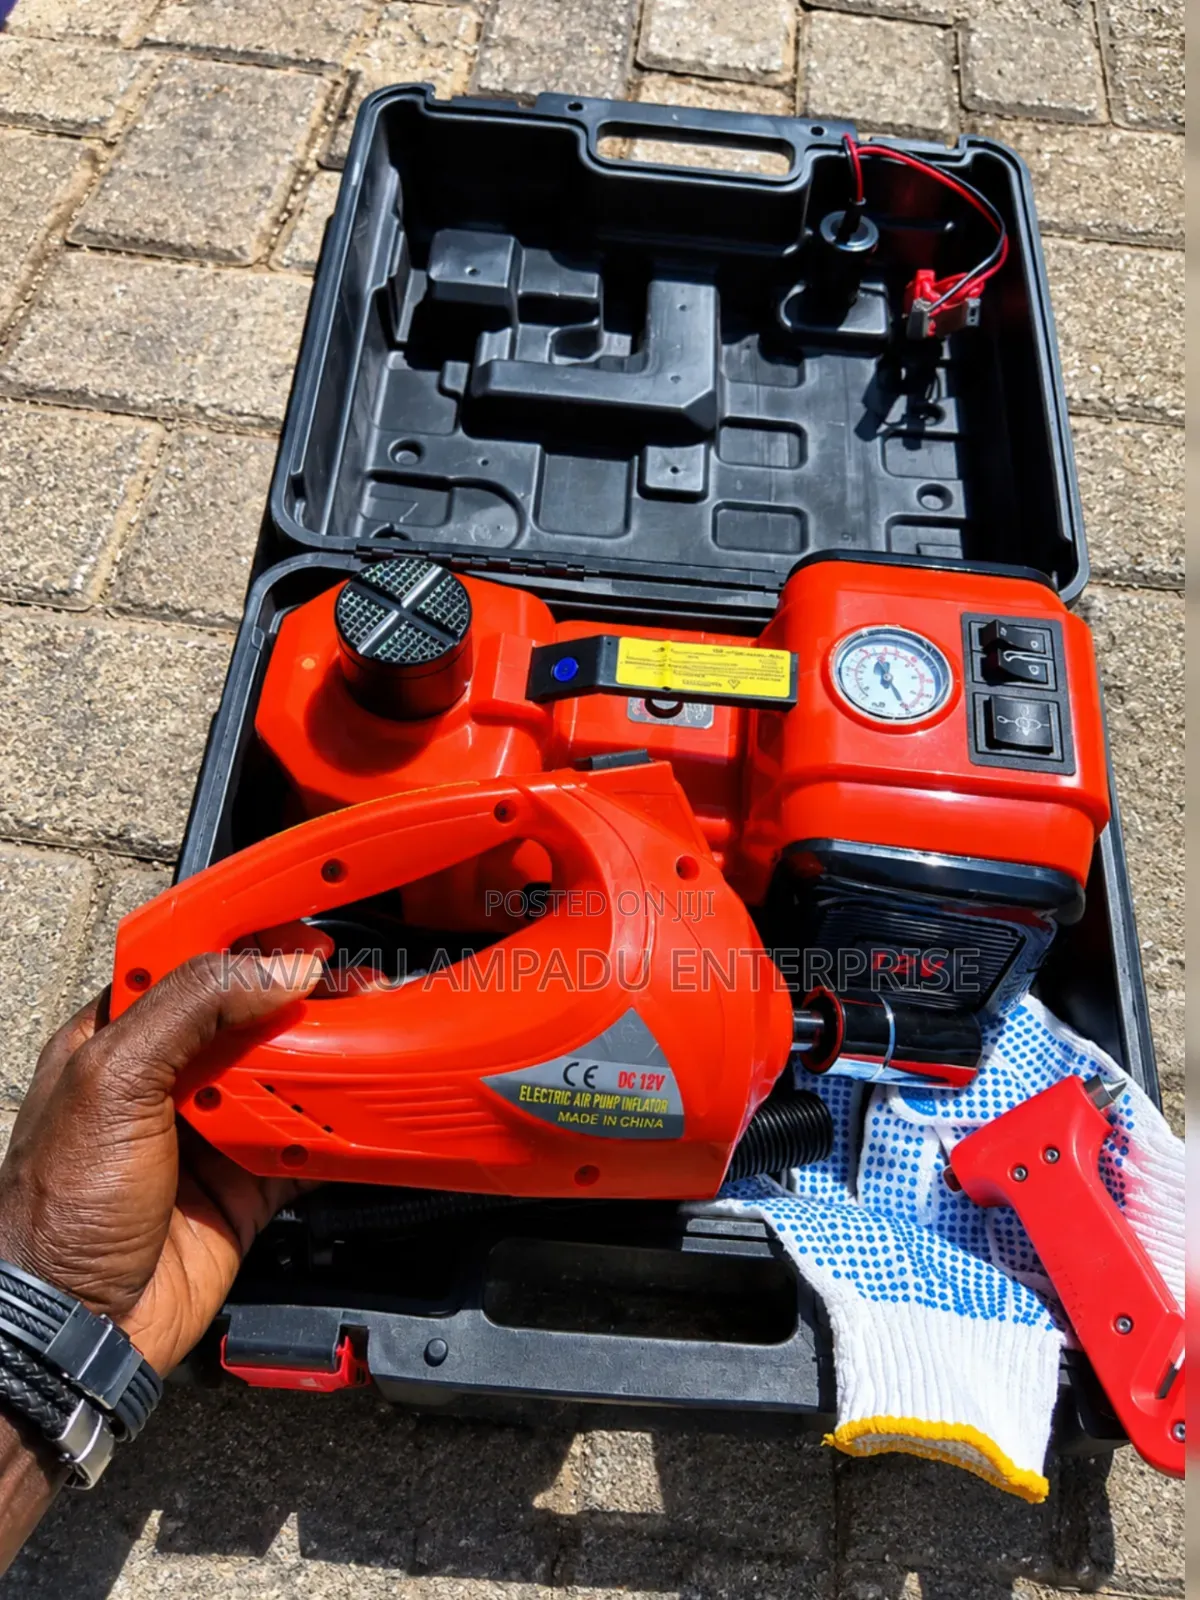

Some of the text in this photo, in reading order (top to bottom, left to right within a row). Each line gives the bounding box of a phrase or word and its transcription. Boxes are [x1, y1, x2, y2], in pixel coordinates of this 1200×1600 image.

[563, 1062, 598, 1089] CE
[618, 1071, 665, 1091] DC 12V
[519, 1085, 668, 1113] ELECTRIC AIR PUMP INFLATOR
[558, 1111, 664, 1128] MADE IN CHINA
